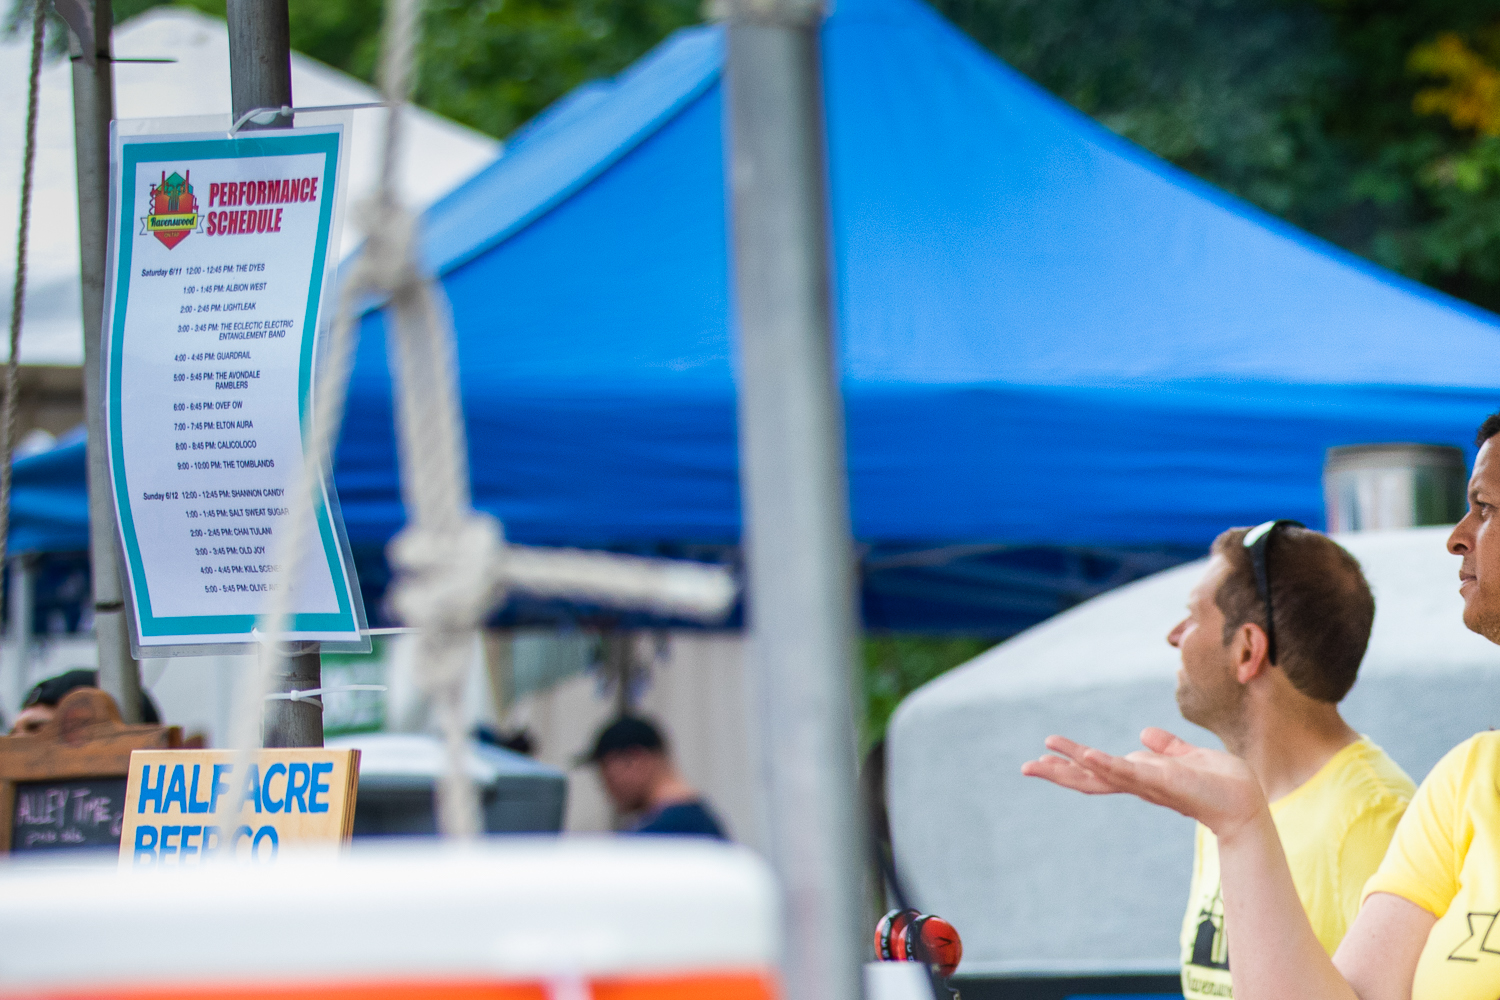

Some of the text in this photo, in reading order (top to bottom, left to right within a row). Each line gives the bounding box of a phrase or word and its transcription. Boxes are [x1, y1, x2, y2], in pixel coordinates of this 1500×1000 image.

[208, 177, 319, 207] PERFORMANCE
[150, 216, 195, 227] Ravenswood
[206, 208, 284, 236] SCHEDULE
[141, 268, 168, 277] Saturday
[169, 267, 182, 276] 6/11
[186, 267, 201, 275] 12:00
[206, 265, 222, 274] 12:45
[235, 264, 248, 273] THE
[248, 263, 266, 272] DYES
[183, 286, 195, 294] 1:00
[200, 285, 213, 293] 1:45
[225, 283, 249, 292] ALBION
[249, 282, 267, 291] WEST
[180, 305, 193, 313] 2:00
[197, 304, 210, 313] 2:45
[223, 302, 257, 311] LIGHTLEAK
[177, 325, 190, 333] 3:00
[194, 324, 207, 332] 3:45
[220, 322, 233, 331] THE
[233, 321, 263, 330] ECLECTIC
[264, 320, 294, 329] ELECTRIC
[218, 330, 286, 341] ENTANGLEMENT BAND
[174, 354, 187, 362] 4:00
[191, 353, 204, 361] 4:45
[216, 351, 251, 360] GUARDRAIL
[173, 374, 186, 382] 5:00
[190, 372, 203, 381] 5:45
[215, 371, 228, 380] THE
[228, 370, 261, 379] AVONDALE
[215, 381, 249, 390] RAMBLERS
[173, 403, 186, 411] 6:00
[190, 402, 203, 411] 6:45
[215, 401, 231, 410] OVEF
[232, 401, 243, 409] OW
[174, 423, 187, 431] 7:00
[191, 422, 203, 430] 7:45
[216, 421, 236, 430] ELTON
[236, 420, 254, 429] AURA
[175, 442, 188, 451] 8:00
[192, 442, 205, 450] 8:45
[217, 440, 257, 450] CALICOLOCO
[177, 462, 190, 471] 9:00
[194, 461, 210, 470] 10:00
[223, 460, 236, 469] THE
[236, 459, 275, 469] TOMBLANDS
[143, 492, 165, 502] Sunday
[165, 491, 179, 500] 6/12
[182, 491, 198, 499] 12:00
[202, 490, 218, 499] 12:45
[231, 489, 263, 498] SHANNON
[262, 488, 285, 497] CANDY
[186, 510, 198, 519] 1:00
[203, 510, 216, 518] 1:45
[228, 509, 244, 517] SALT
[245, 508, 267, 517] SWEAT
[190, 529, 203, 537] 2:00
[208, 528, 220, 536] 2:45
[233, 527, 249, 536] CHAI
[249, 527, 272, 535] TULANI
[195, 548, 208, 556] 3:00
[212, 547, 226, 555] 3:45
[239, 546, 252, 555] OLD
[253, 546, 265, 554] JOY
[200, 566, 213, 574] 4:00
[218, 566, 231, 574] 4:45
[244, 565, 258, 573] KILL
[204, 585, 218, 593] 5:00
[249, 584, 268, 592] OLIVE
[138, 763, 334, 814] HALF ACRE
